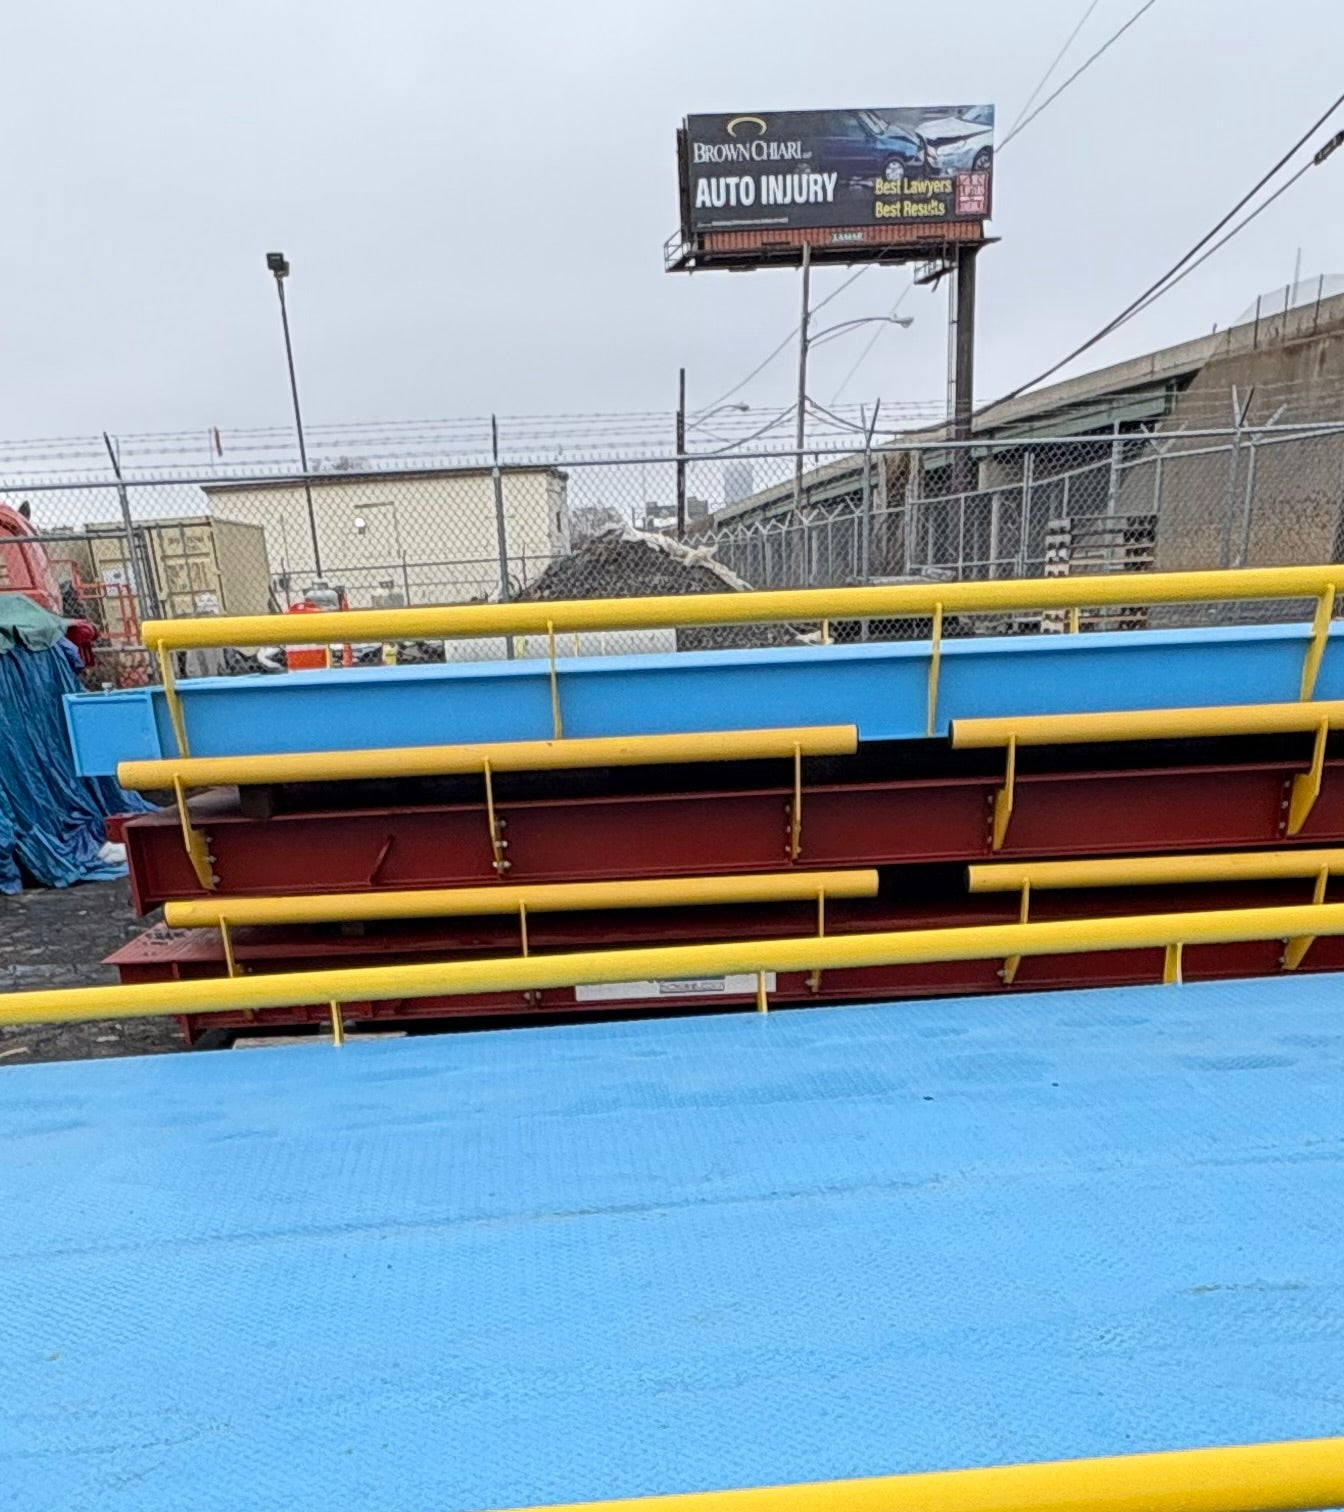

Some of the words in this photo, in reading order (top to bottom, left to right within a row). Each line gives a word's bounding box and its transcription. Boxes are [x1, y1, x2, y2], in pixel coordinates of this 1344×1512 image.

[695, 175, 755, 208] AUTO
[761, 172, 837, 205] INJURY
[874, 178, 901, 195] Best
[903, 178, 953, 197] Lawyers
[874, 201, 901, 218] Best
[903, 199, 945, 217] Results
